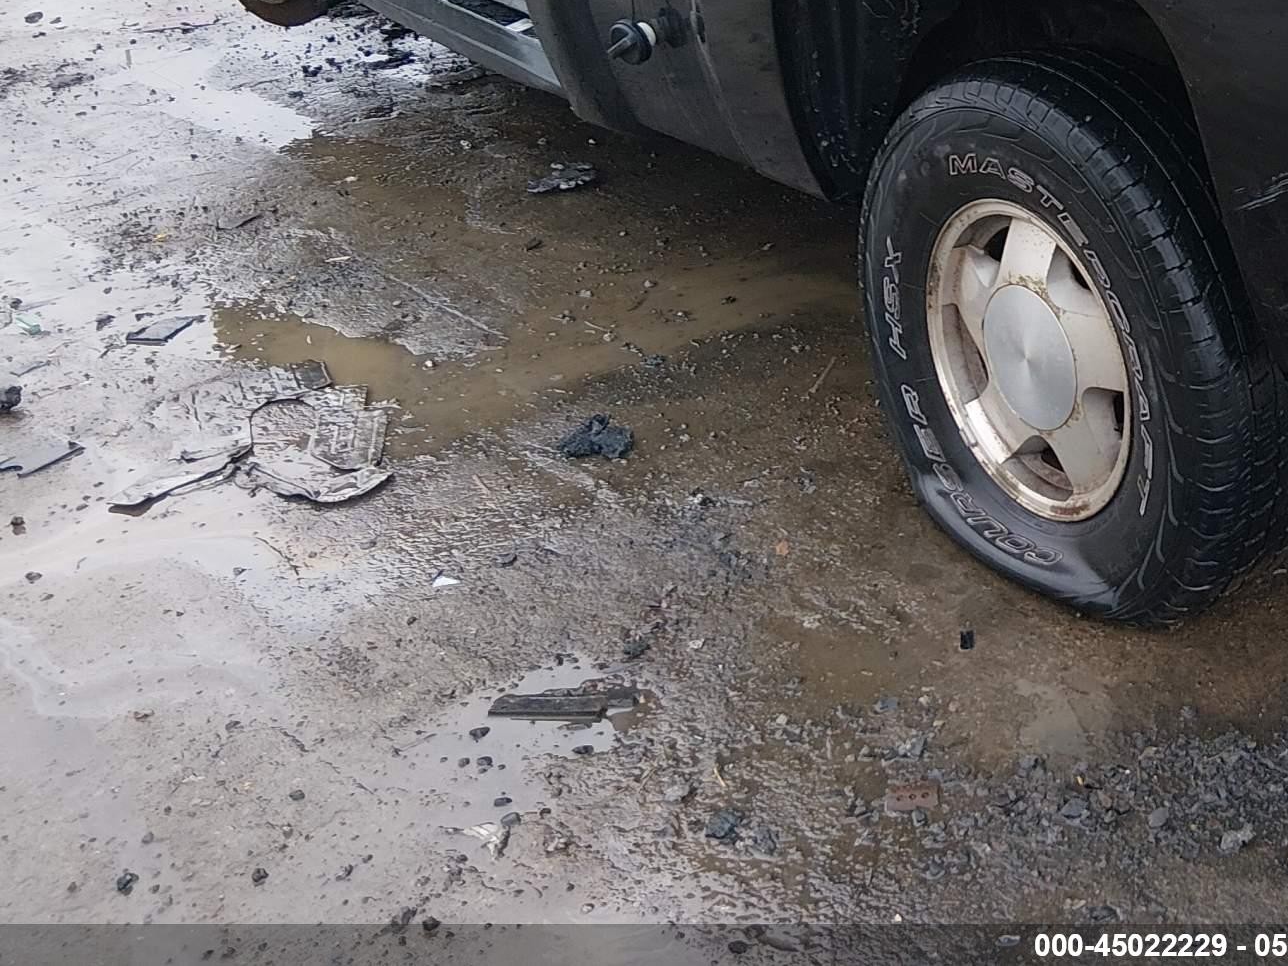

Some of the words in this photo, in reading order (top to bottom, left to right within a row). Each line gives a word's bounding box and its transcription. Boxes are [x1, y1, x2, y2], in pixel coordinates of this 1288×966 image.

[884, 235, 907, 360] HSX
[949, 152, 1154, 517] MASTERCRAFT
[900, 384, 1063, 566] COURSER
